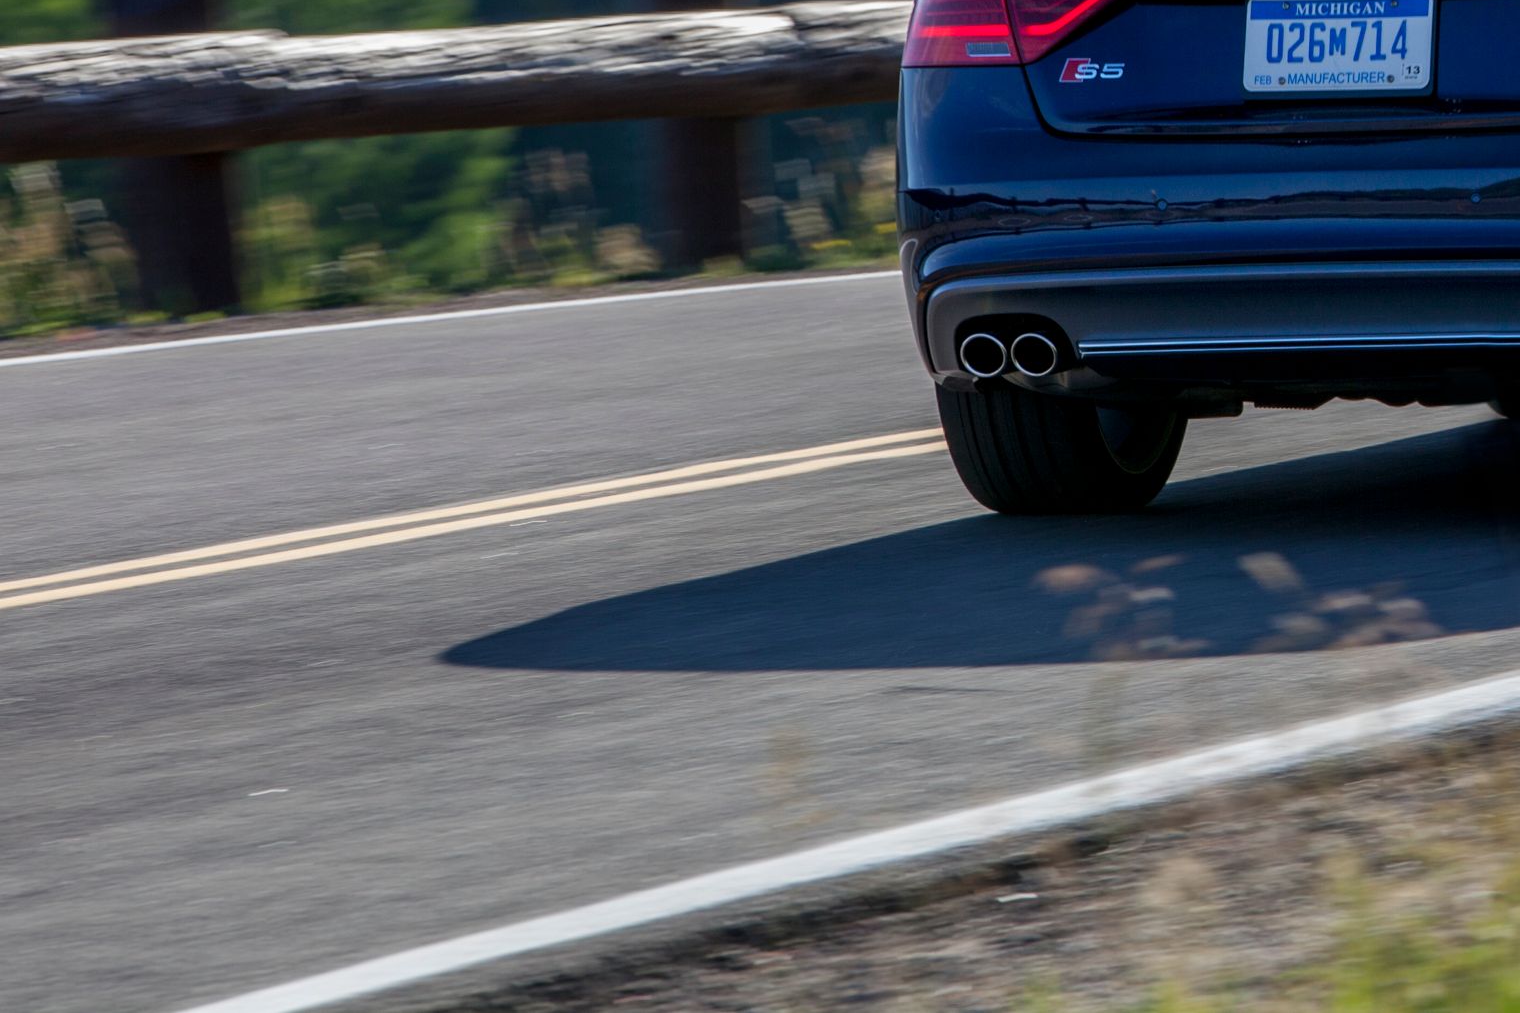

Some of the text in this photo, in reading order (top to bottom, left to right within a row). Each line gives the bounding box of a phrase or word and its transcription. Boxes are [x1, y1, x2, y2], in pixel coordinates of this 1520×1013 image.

[1295, 1, 1386, 16] MICHIGAN
[1266, 19, 1408, 64] 026M714
[1074, 63, 1125, 79] S5
[1406, 65, 1421, 75] 13
[1254, 71, 1385, 85] FEB MANUFACTURER
